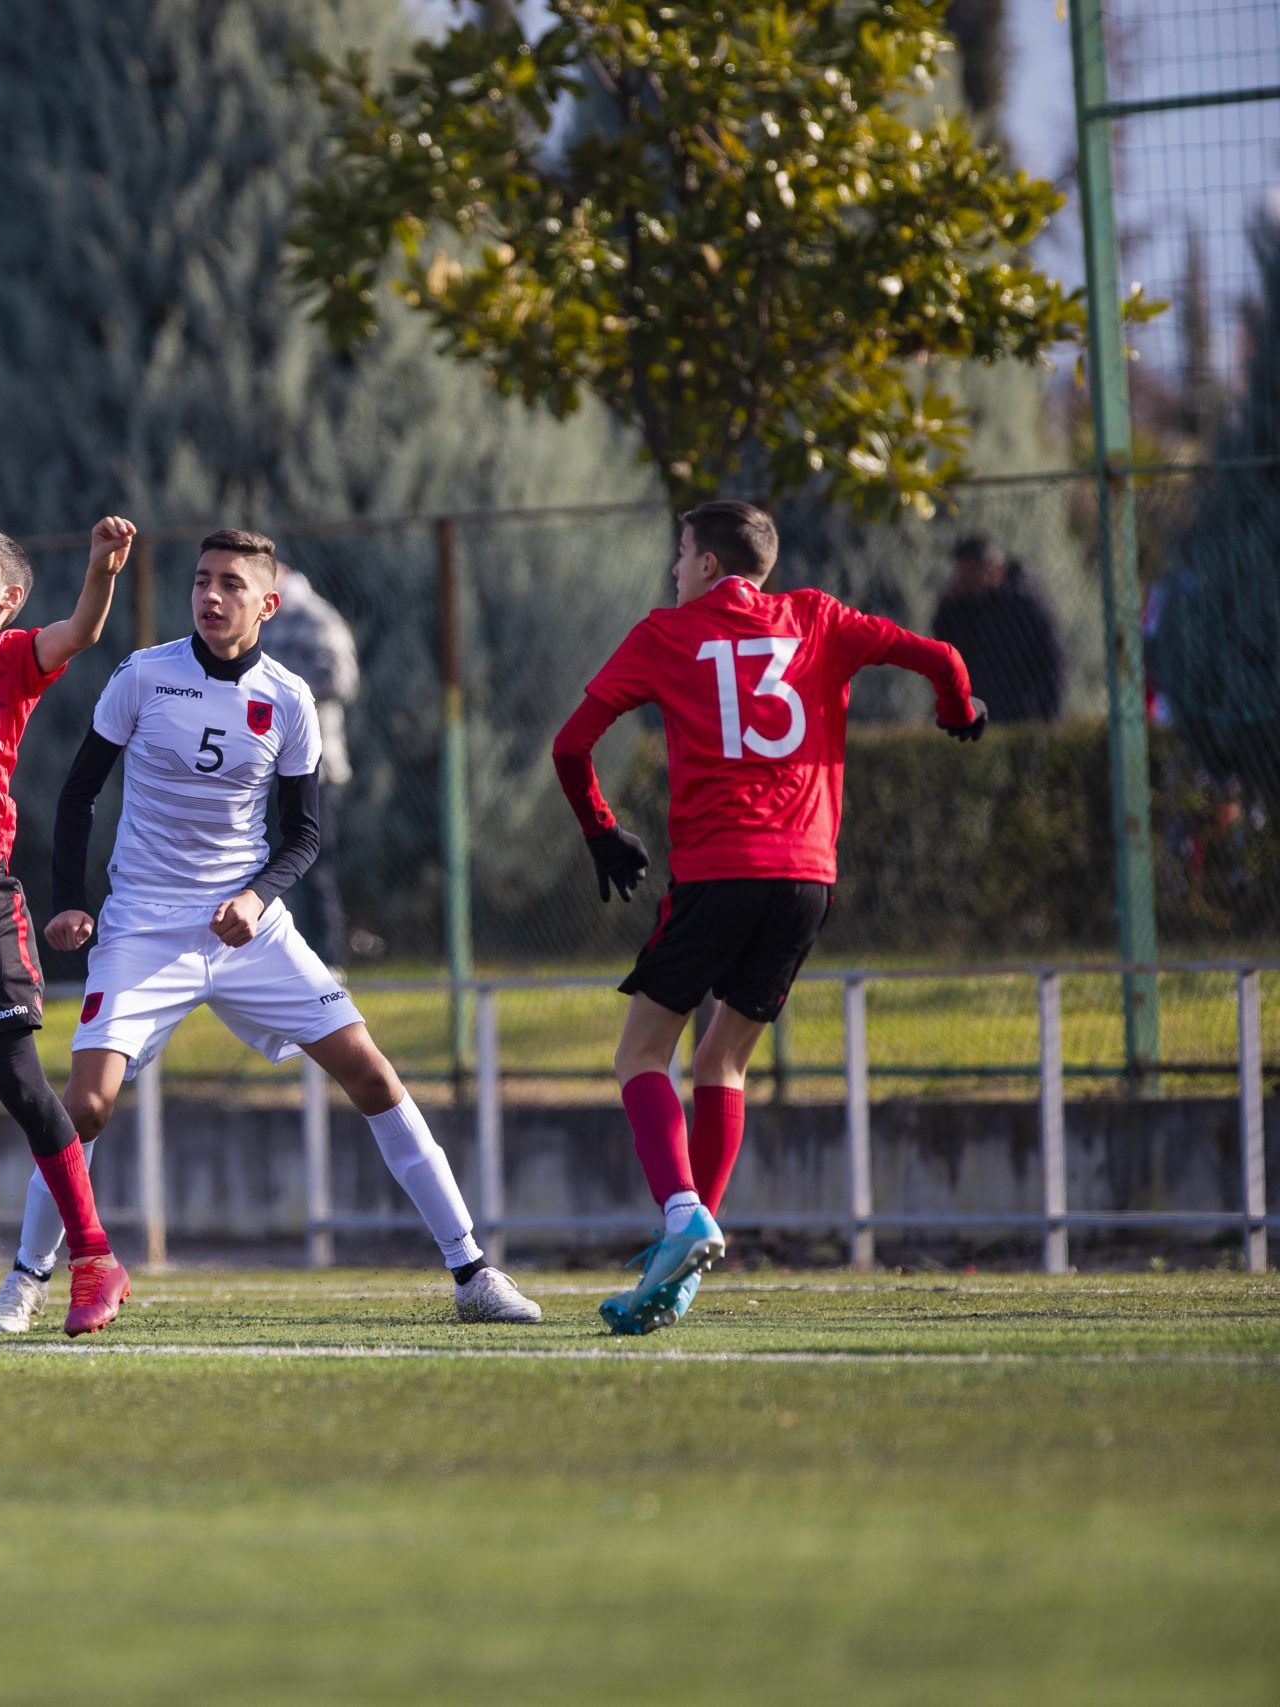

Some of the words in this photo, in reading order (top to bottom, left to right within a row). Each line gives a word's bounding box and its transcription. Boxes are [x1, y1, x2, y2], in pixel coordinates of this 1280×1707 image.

[156, 686, 203, 699] macron
[696, 637, 806, 759] 13
[195, 727, 226, 773] 5
